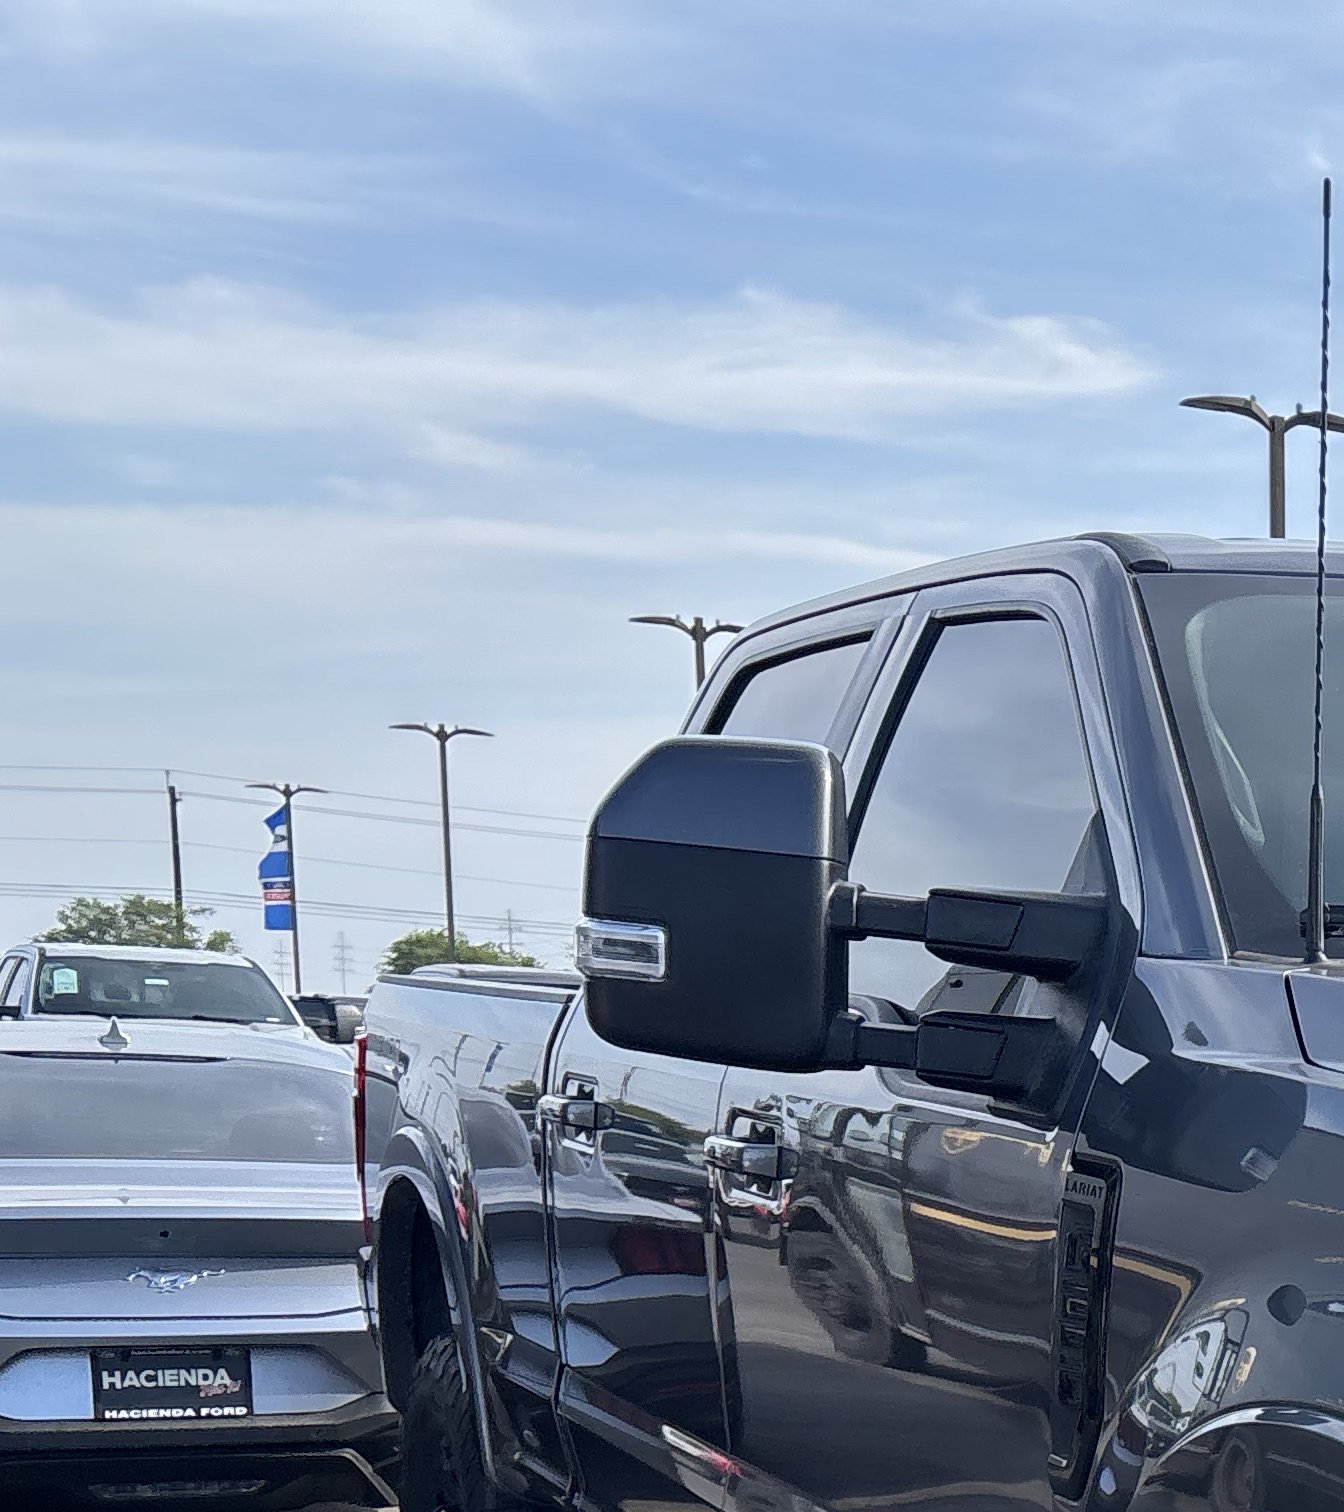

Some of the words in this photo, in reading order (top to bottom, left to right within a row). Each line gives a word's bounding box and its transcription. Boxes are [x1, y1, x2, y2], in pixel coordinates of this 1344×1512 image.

[1064, 1178, 1105, 1199] LARIAT
[101, 1367, 232, 1390] HACIENDA
[104, 1408, 196, 1419] HACIENDA
[200, 1406, 248, 1417] FORD
